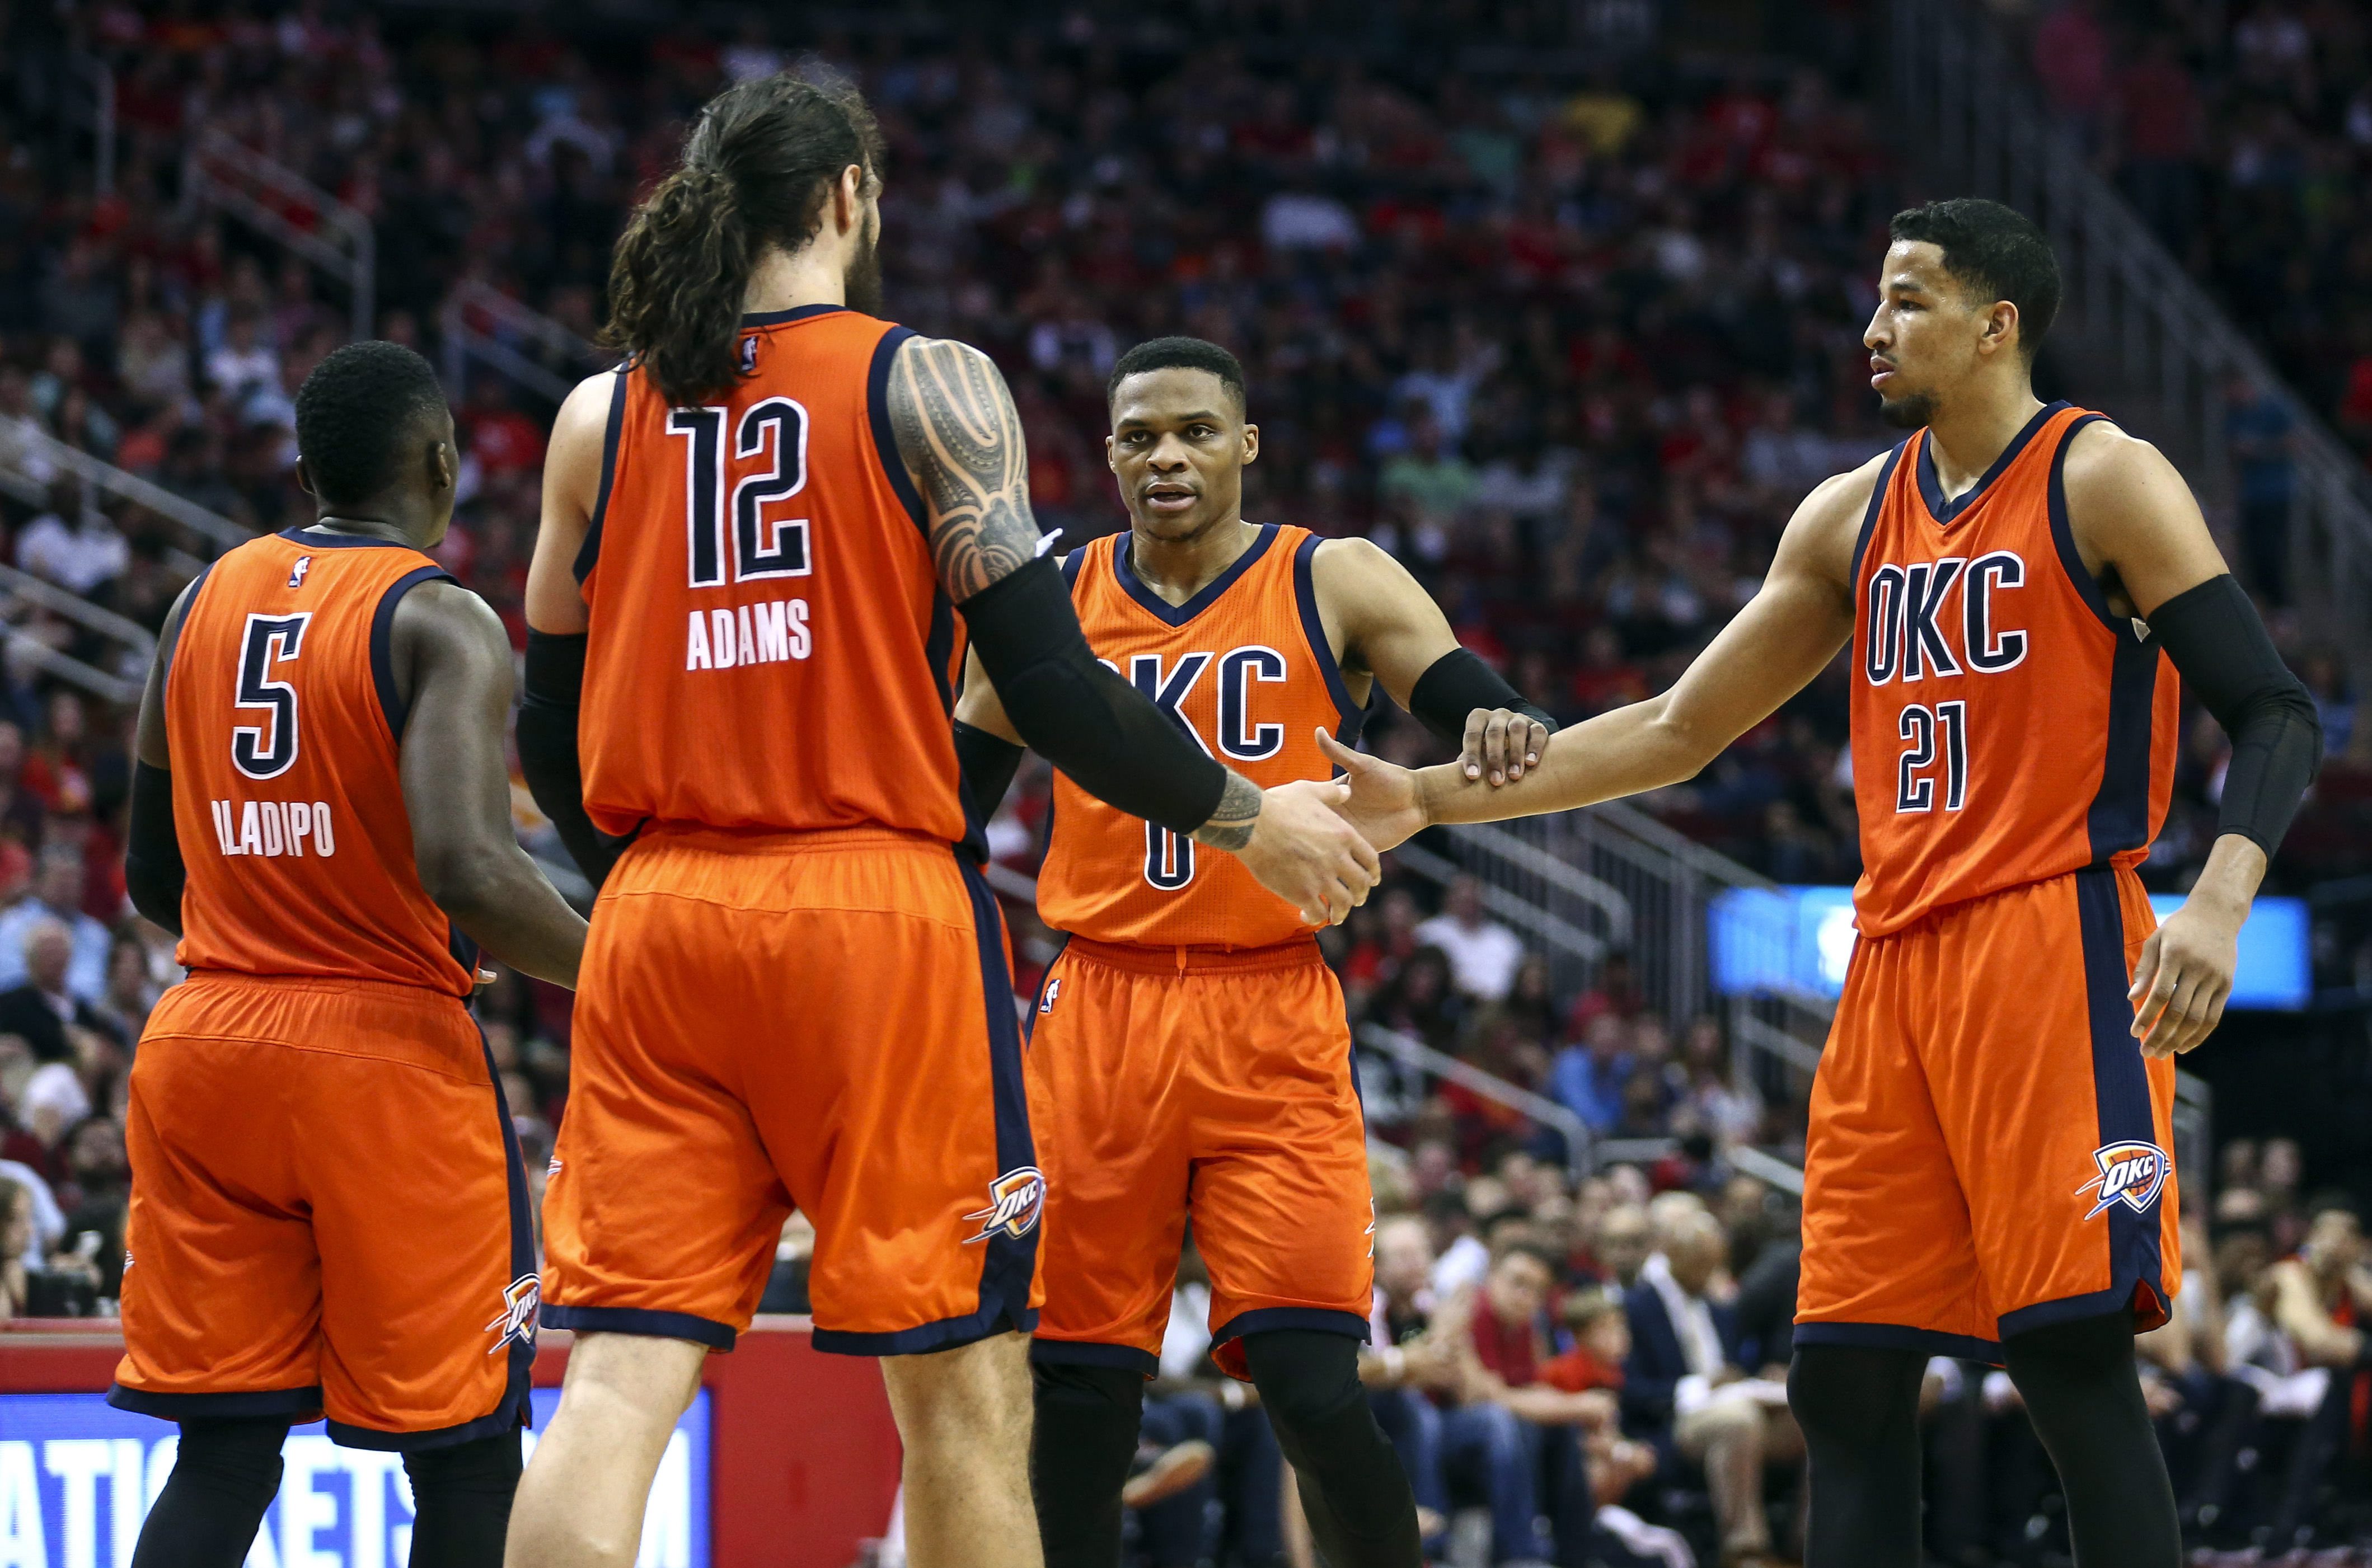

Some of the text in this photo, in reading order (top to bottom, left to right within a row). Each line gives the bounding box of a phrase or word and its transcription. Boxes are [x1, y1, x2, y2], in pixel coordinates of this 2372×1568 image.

[666, 396, 812, 588] 12
[686, 599, 812, 670] ADAMS
[1866, 551, 2027, 686] OKC
[231, 612, 313, 780] 5
[1097, 645, 1286, 762] KC
[1896, 700, 1968, 813] 21
[987, 1179, 1037, 1228] OKC
[2102, 1155, 2155, 1198] OKC
